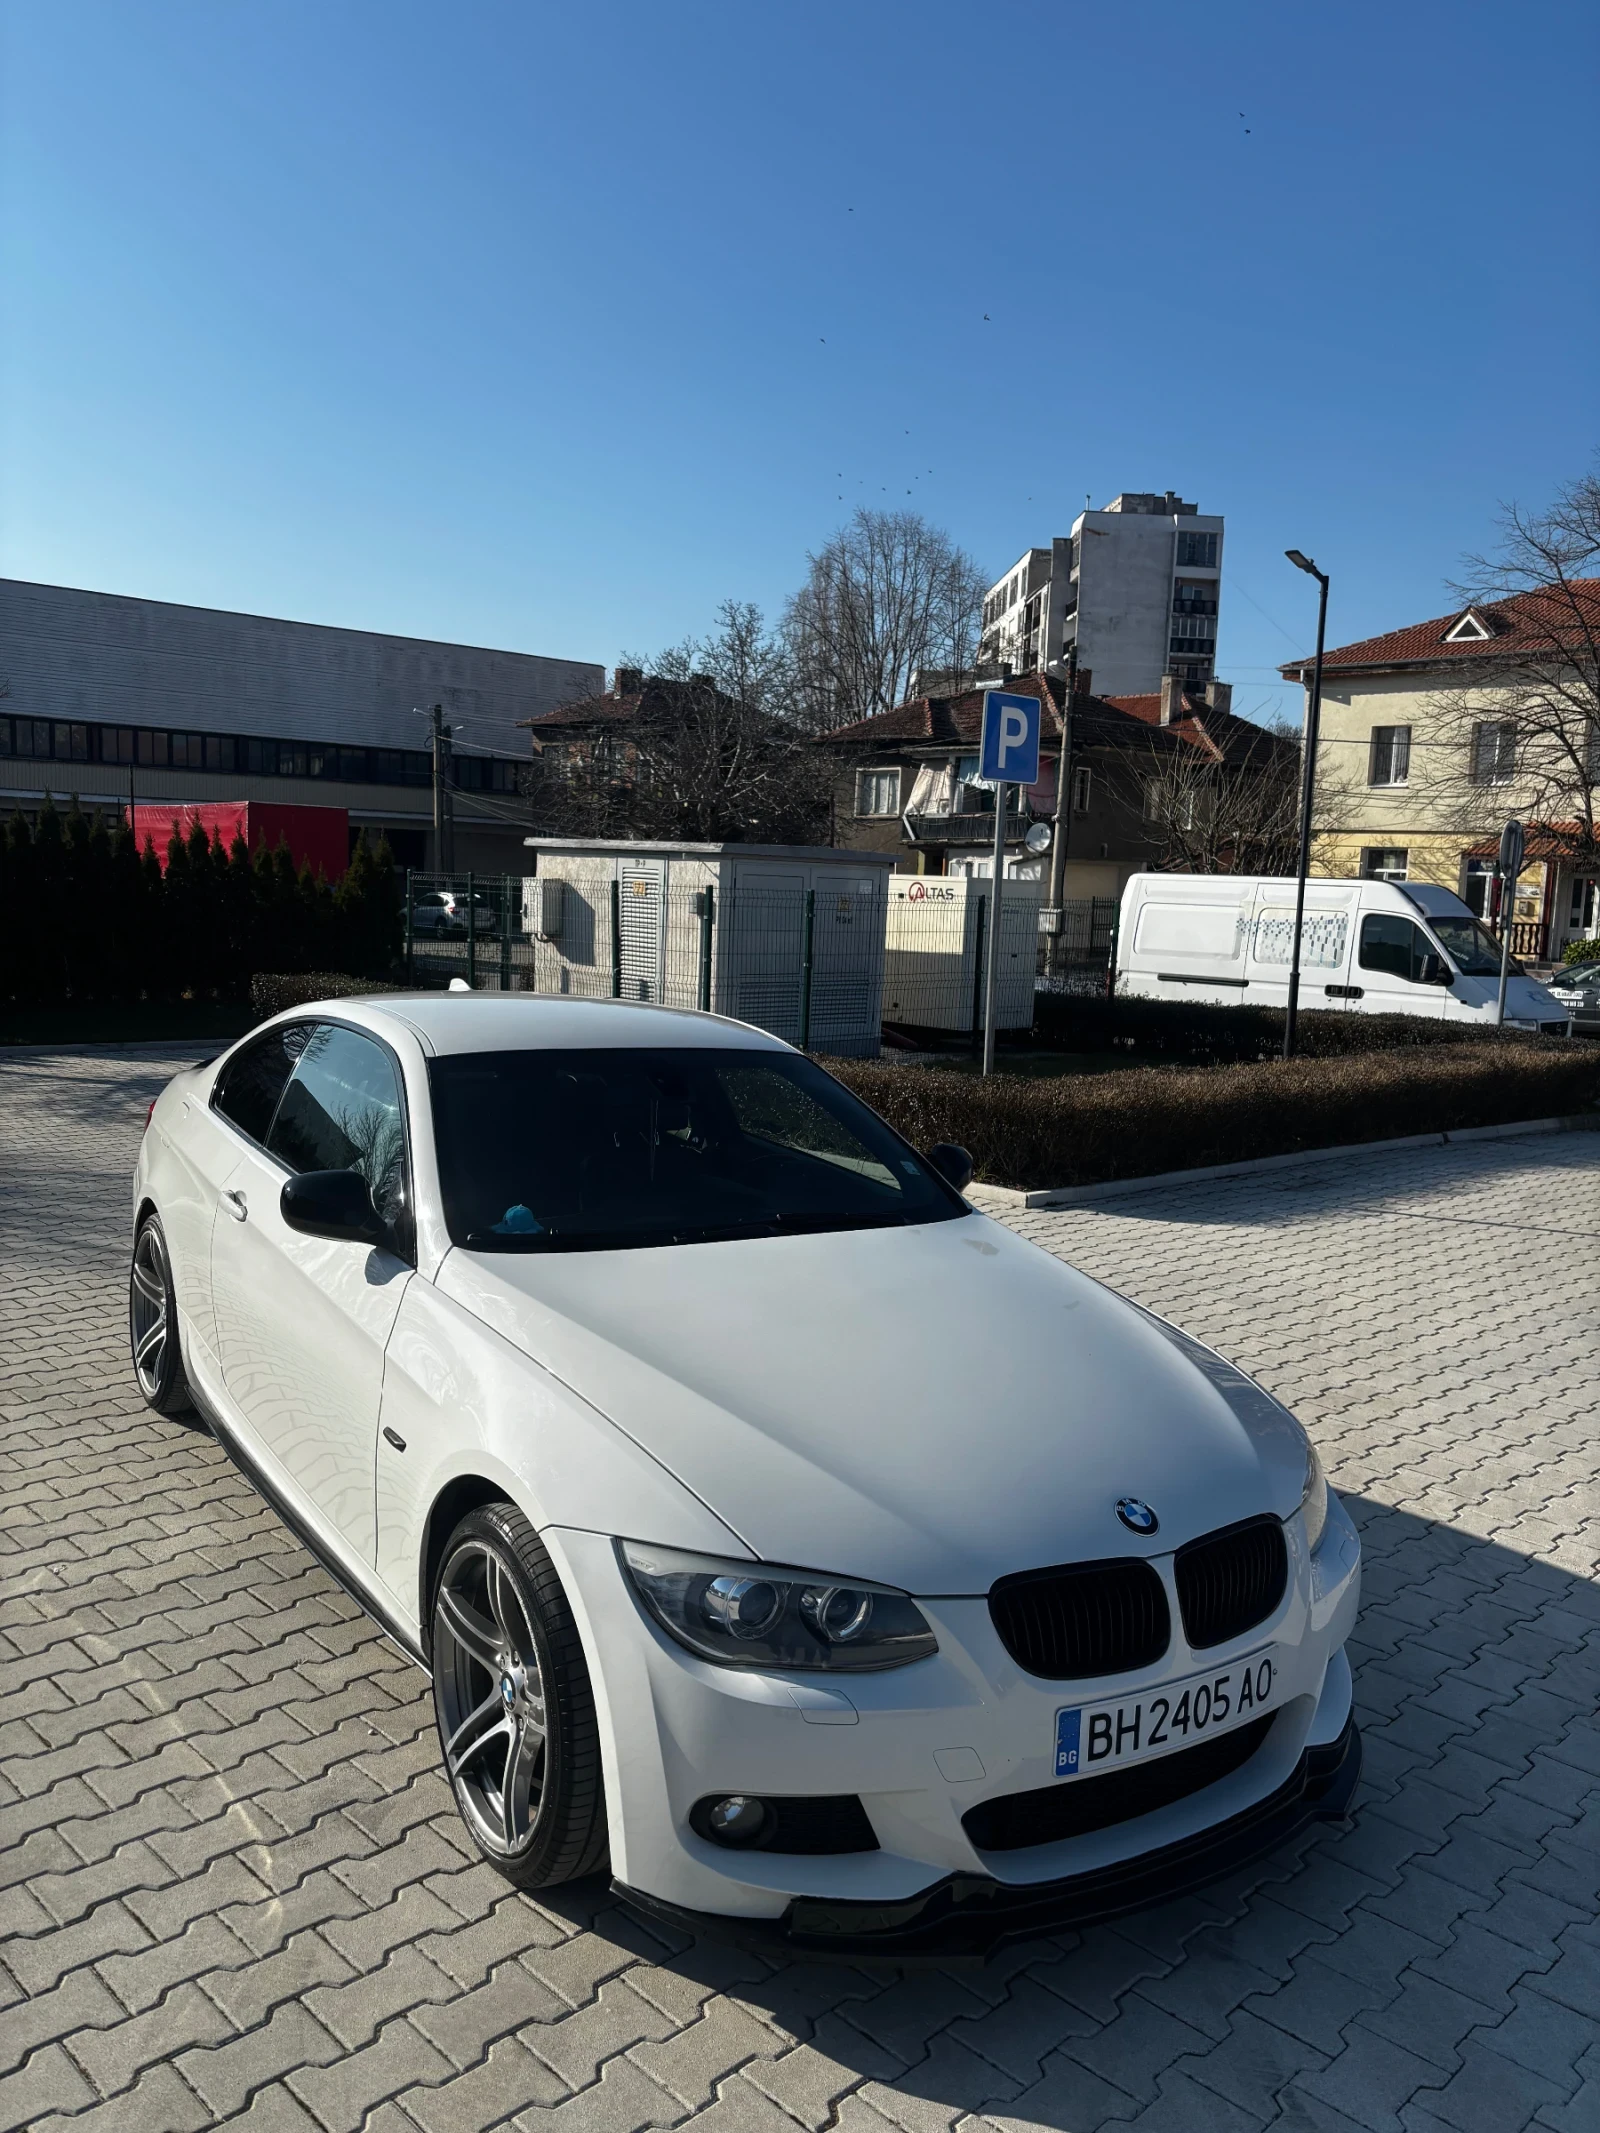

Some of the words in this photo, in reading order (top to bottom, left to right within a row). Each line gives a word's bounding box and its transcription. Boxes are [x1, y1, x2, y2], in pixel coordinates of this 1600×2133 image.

[998, 706, 1029, 769] P
[1087, 1704, 1142, 1762] BH
[1147, 1675, 1230, 1747] 2405
[1236, 1658, 1272, 1714] AO
[1058, 1750, 1077, 1766] BG
